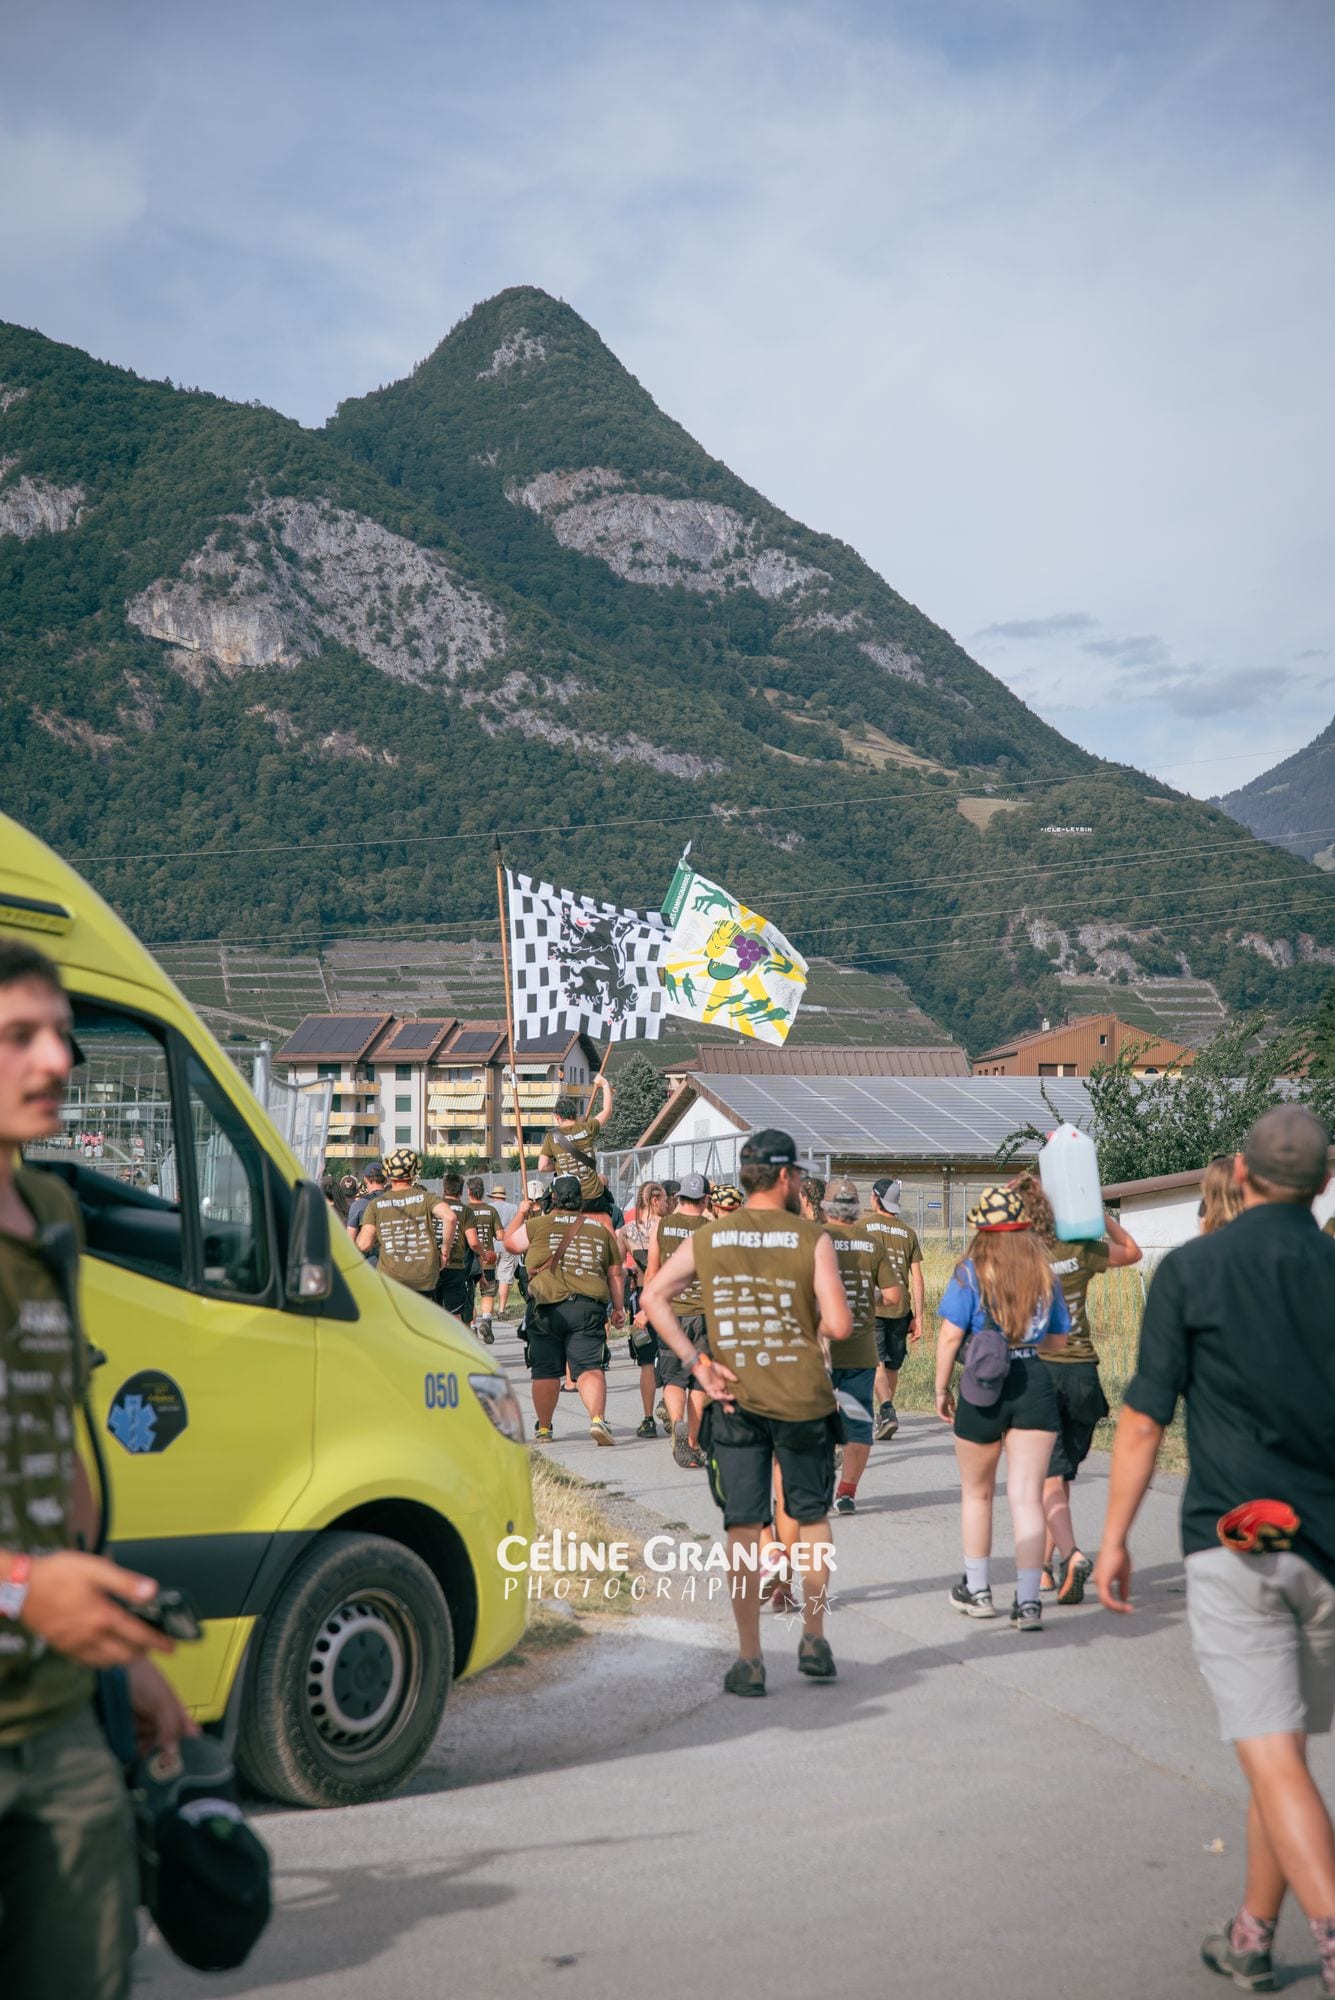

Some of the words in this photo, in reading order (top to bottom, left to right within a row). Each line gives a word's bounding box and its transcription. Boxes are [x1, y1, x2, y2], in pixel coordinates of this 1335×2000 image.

[663, 1226, 677, 1237] NAIN
[677, 1227, 689, 1239] DES
[866, 1222, 881, 1233] NAIN
[890, 1226, 908, 1239] MINES
[712, 1230, 738, 1248] NAIN
[740, 1231, 761, 1248] DES
[762, 1231, 799, 1249] MINES
[834, 1240, 849, 1251] DES
[850, 1240, 875, 1253] MINES
[425, 1372, 459, 1409] 050
